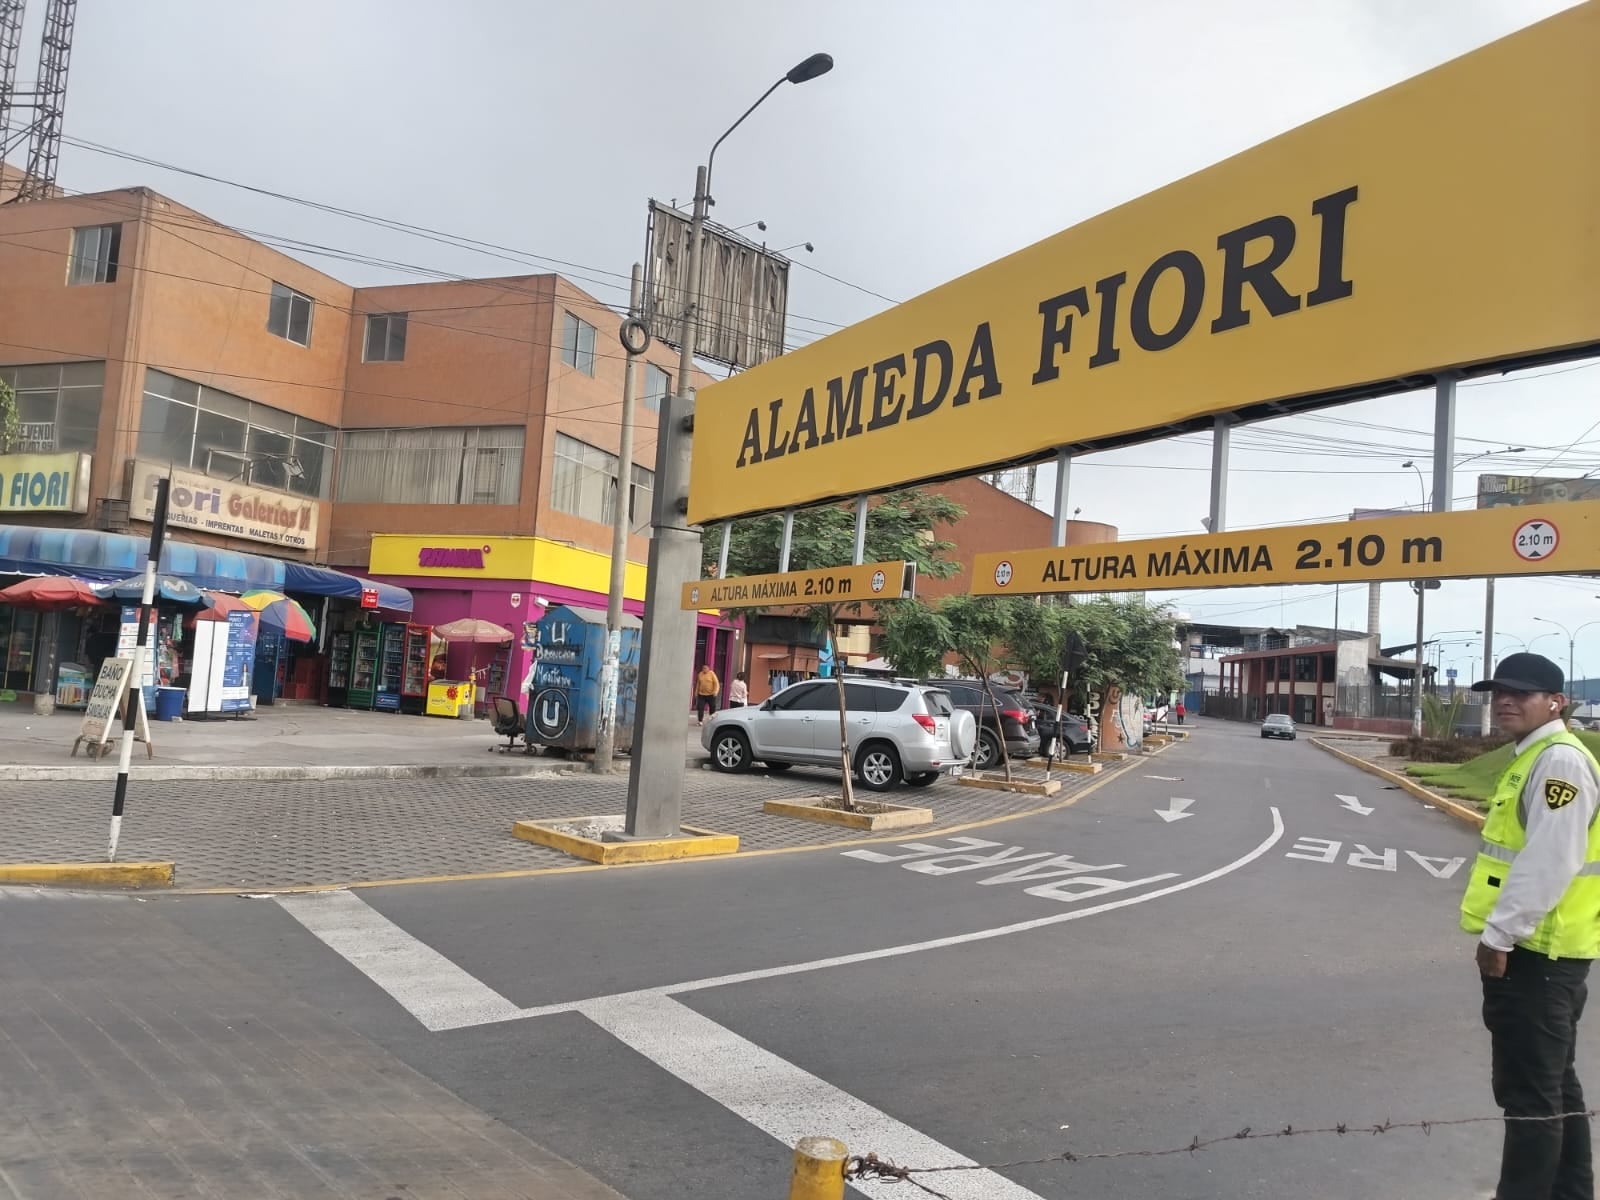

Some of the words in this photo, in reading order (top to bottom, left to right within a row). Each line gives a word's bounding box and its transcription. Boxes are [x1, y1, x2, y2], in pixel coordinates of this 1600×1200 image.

[736, 321, 1002, 469] ALAMEDA
[1032, 185, 1359, 387] FIORI
[9, 471, 70, 507] FIORI
[205, 519, 244, 534] IMPRENTAS
[249, 527, 278, 541] MALETAS
[285, 534, 306, 546] OTROS
[1518, 534, 1540, 547] 2.10
[1543, 535, 1553, 545] m
[1041, 553, 1138, 584] ALTURA
[1146, 543, 1274, 578] MÁXIMA
[1295, 533, 1387, 571] 2.10
[1401, 535, 1444, 565] m
[710, 585, 749, 603] ALTURA
[752, 579, 798, 600] MÁXIMA
[804, 577, 834, 596] 2.10
[838, 577, 852, 594] m
[100, 663, 124, 681] BAÑO
[1548, 785, 1574, 806] SP
[840, 836, 1183, 903] PARE
